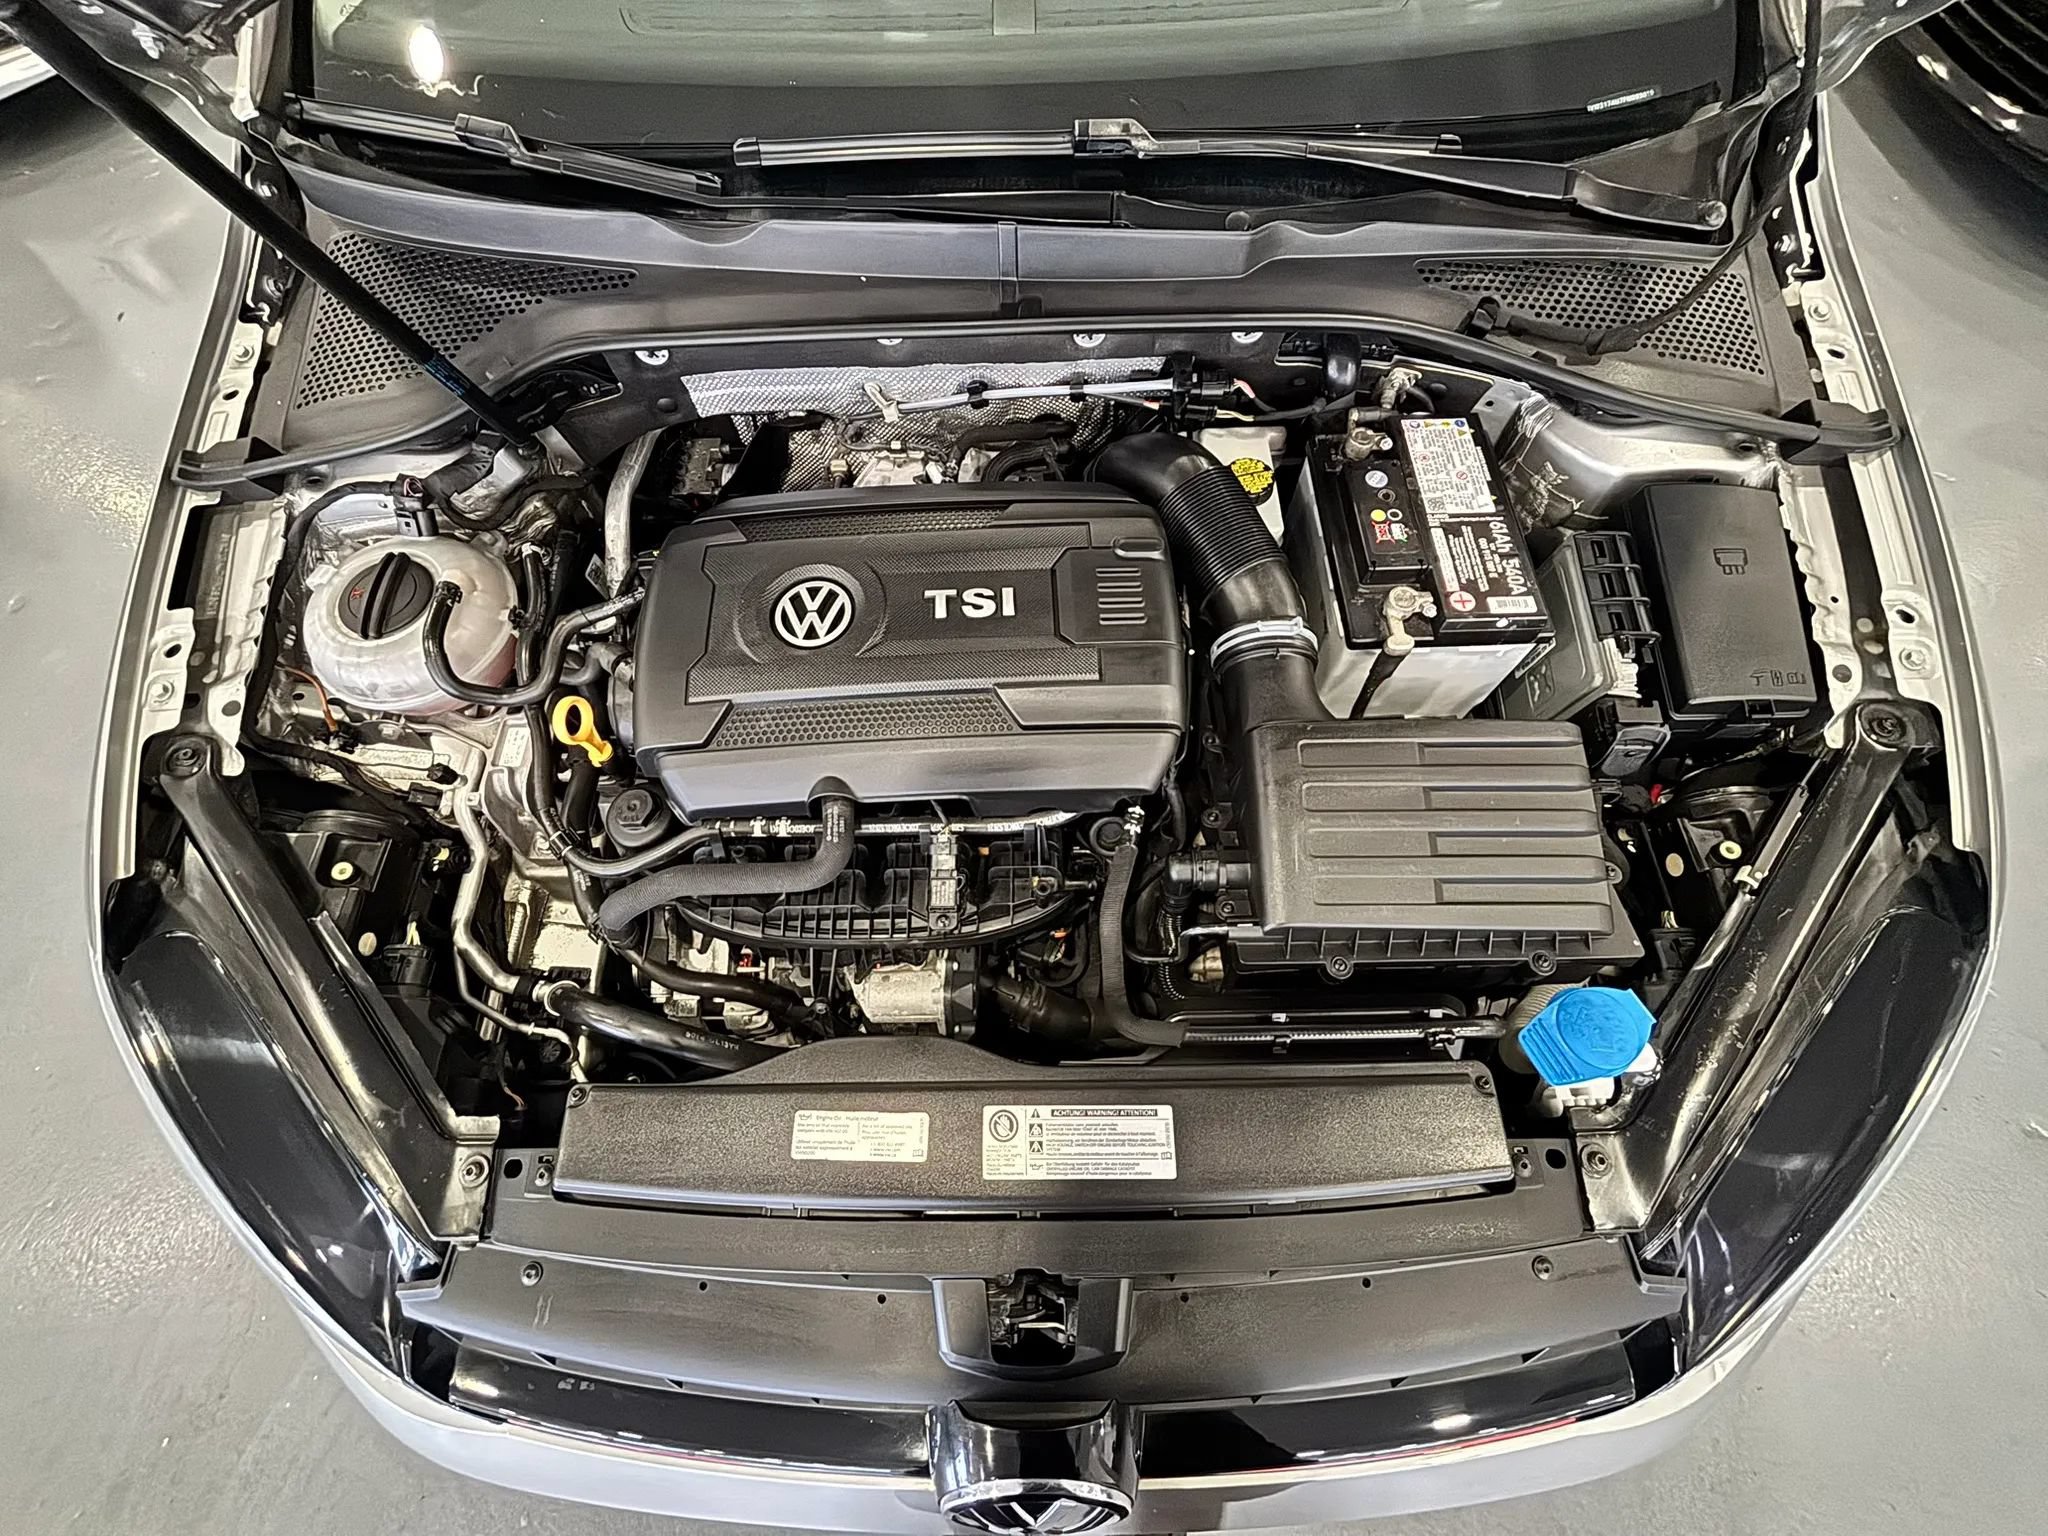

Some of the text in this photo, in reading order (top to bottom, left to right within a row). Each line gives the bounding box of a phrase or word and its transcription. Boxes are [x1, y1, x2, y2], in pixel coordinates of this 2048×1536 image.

[1489, 521, 1514, 553] 61Ah
[1501, 558, 1527, 595] 540A
[774, 580, 852, 648] VW
[923, 586, 1015, 619] TSI
[1053, 1109, 1086, 1117] ACHTUNG!
[1087, 1109, 1119, 1117] WARNING!
